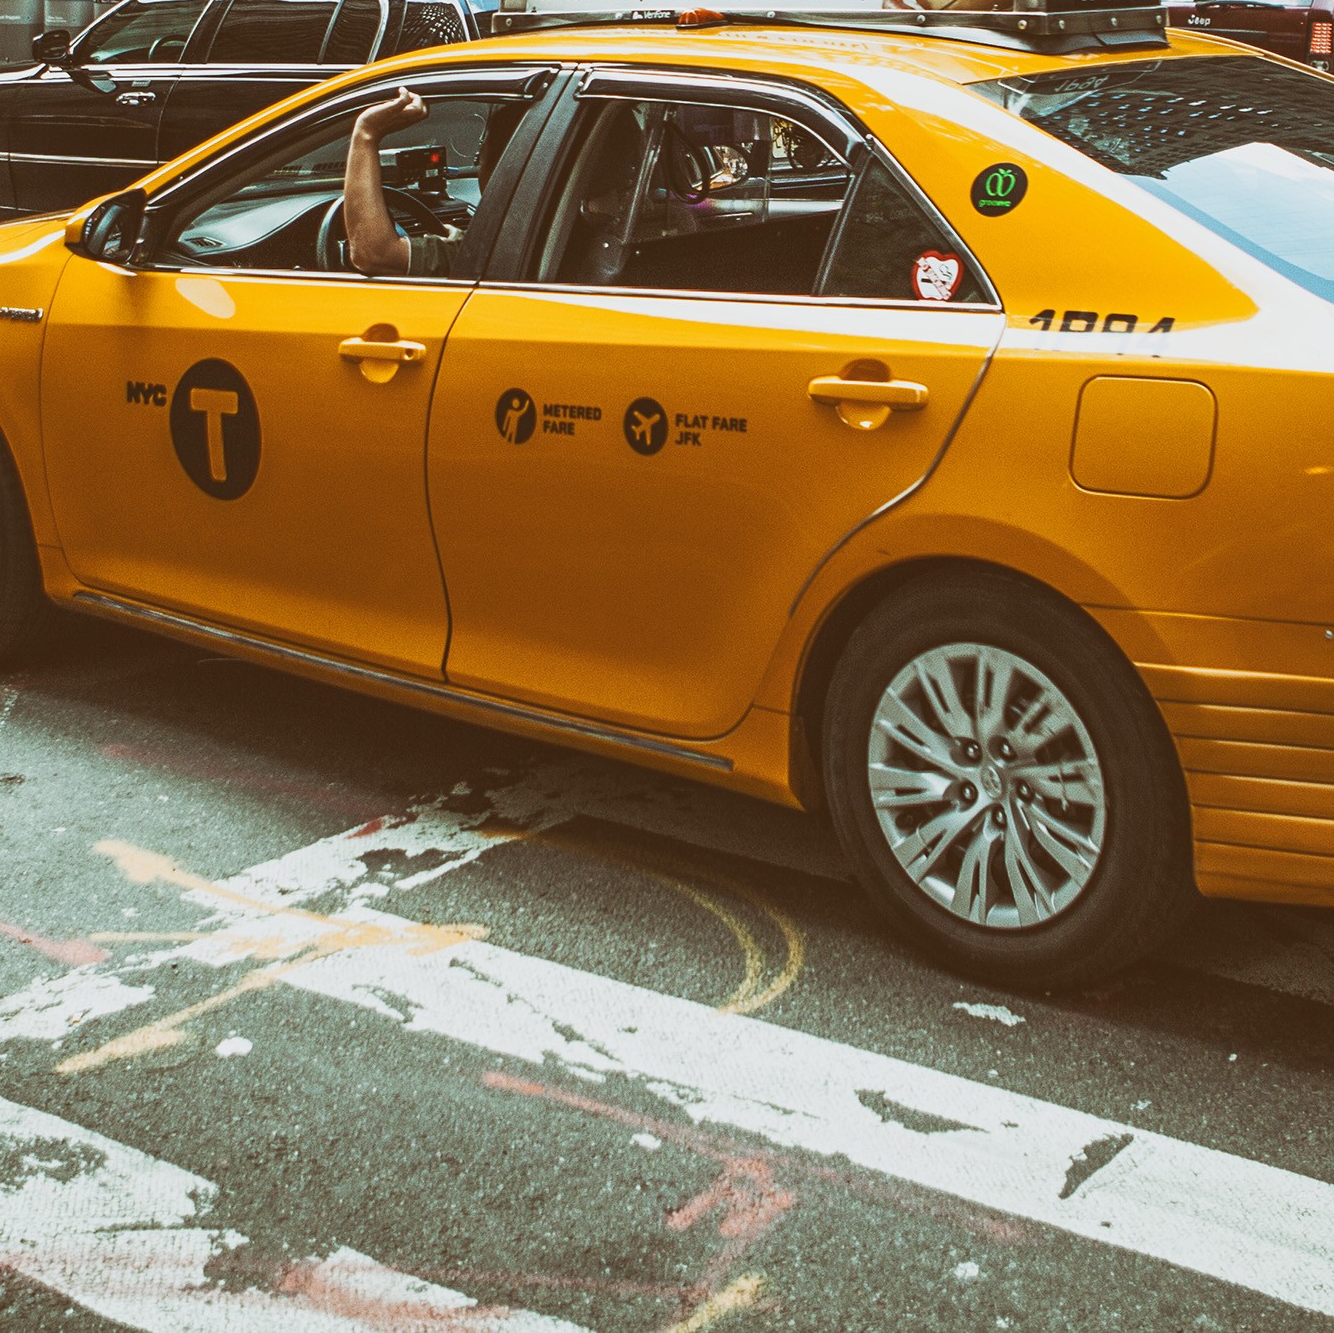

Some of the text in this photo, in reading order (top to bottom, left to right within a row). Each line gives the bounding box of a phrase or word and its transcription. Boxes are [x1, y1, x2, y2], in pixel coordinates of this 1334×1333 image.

[1187, 14, 1211, 26] Jeep
[543, 403, 602, 422] METERED
[126, 380, 239, 482] NYC T
[543, 420, 575, 436] FARE
[675, 413, 748, 433] FLAT FARE
[675, 431, 702, 447] JFK
